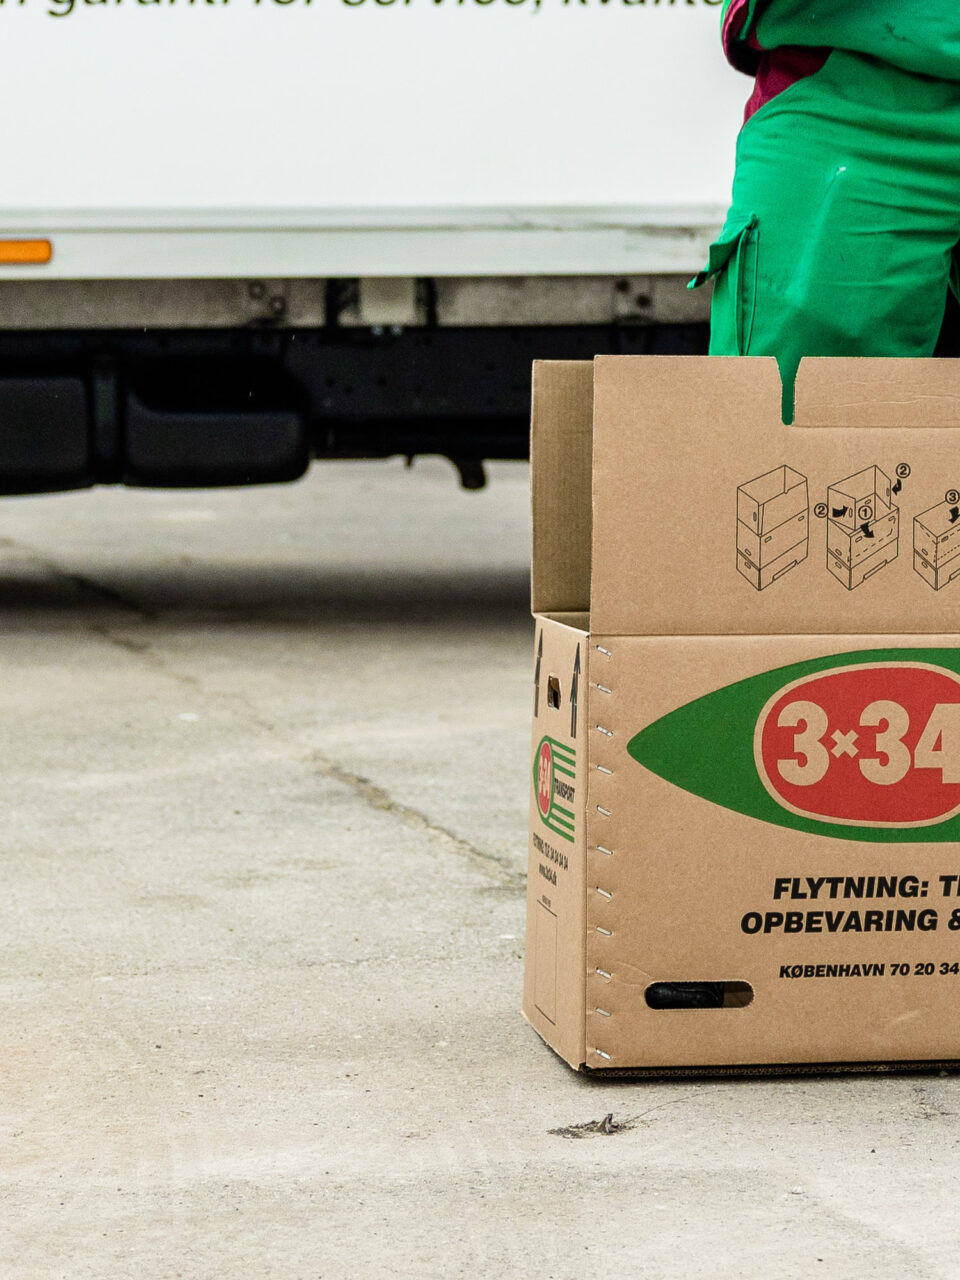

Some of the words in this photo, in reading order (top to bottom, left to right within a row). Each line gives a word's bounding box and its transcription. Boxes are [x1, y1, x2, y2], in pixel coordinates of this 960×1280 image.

[773, 875, 929, 900] FLYTNING:
[740, 909, 938, 934] OPBEVARING
[779, 963, 886, 979] KØBENHAVN
[889, 962, 911, 977] 70
[913, 962, 936, 976] 20
[938, 962, 960, 976] 34
